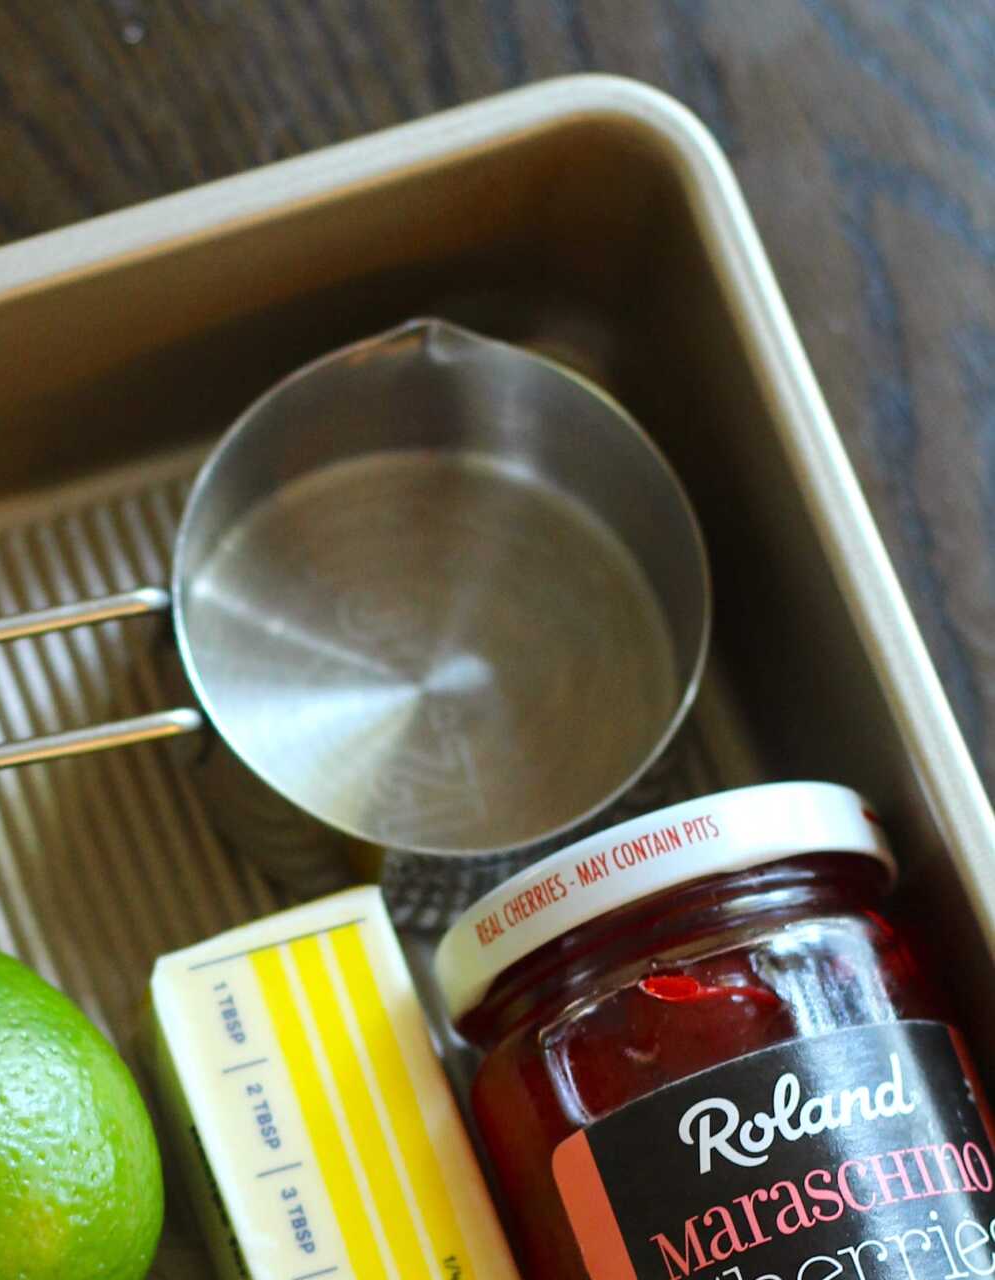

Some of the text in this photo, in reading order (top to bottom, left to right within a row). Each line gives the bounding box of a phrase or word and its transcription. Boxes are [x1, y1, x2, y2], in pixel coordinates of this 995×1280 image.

[475, 915, 505, 946] REAL
[503, 873, 569, 929] CHERRIES
[574, 851, 610, 888] MAY
[612, 827, 683, 870] CONTAIN
[682, 814, 720, 844] PITS
[213, 981, 246, 1045] 1 TBSP
[246, 1082, 282, 1150] 2 TBSP
[678, 1053, 914, 1174] Roland
[280, 1186, 316, 1254] 3 TBSP
